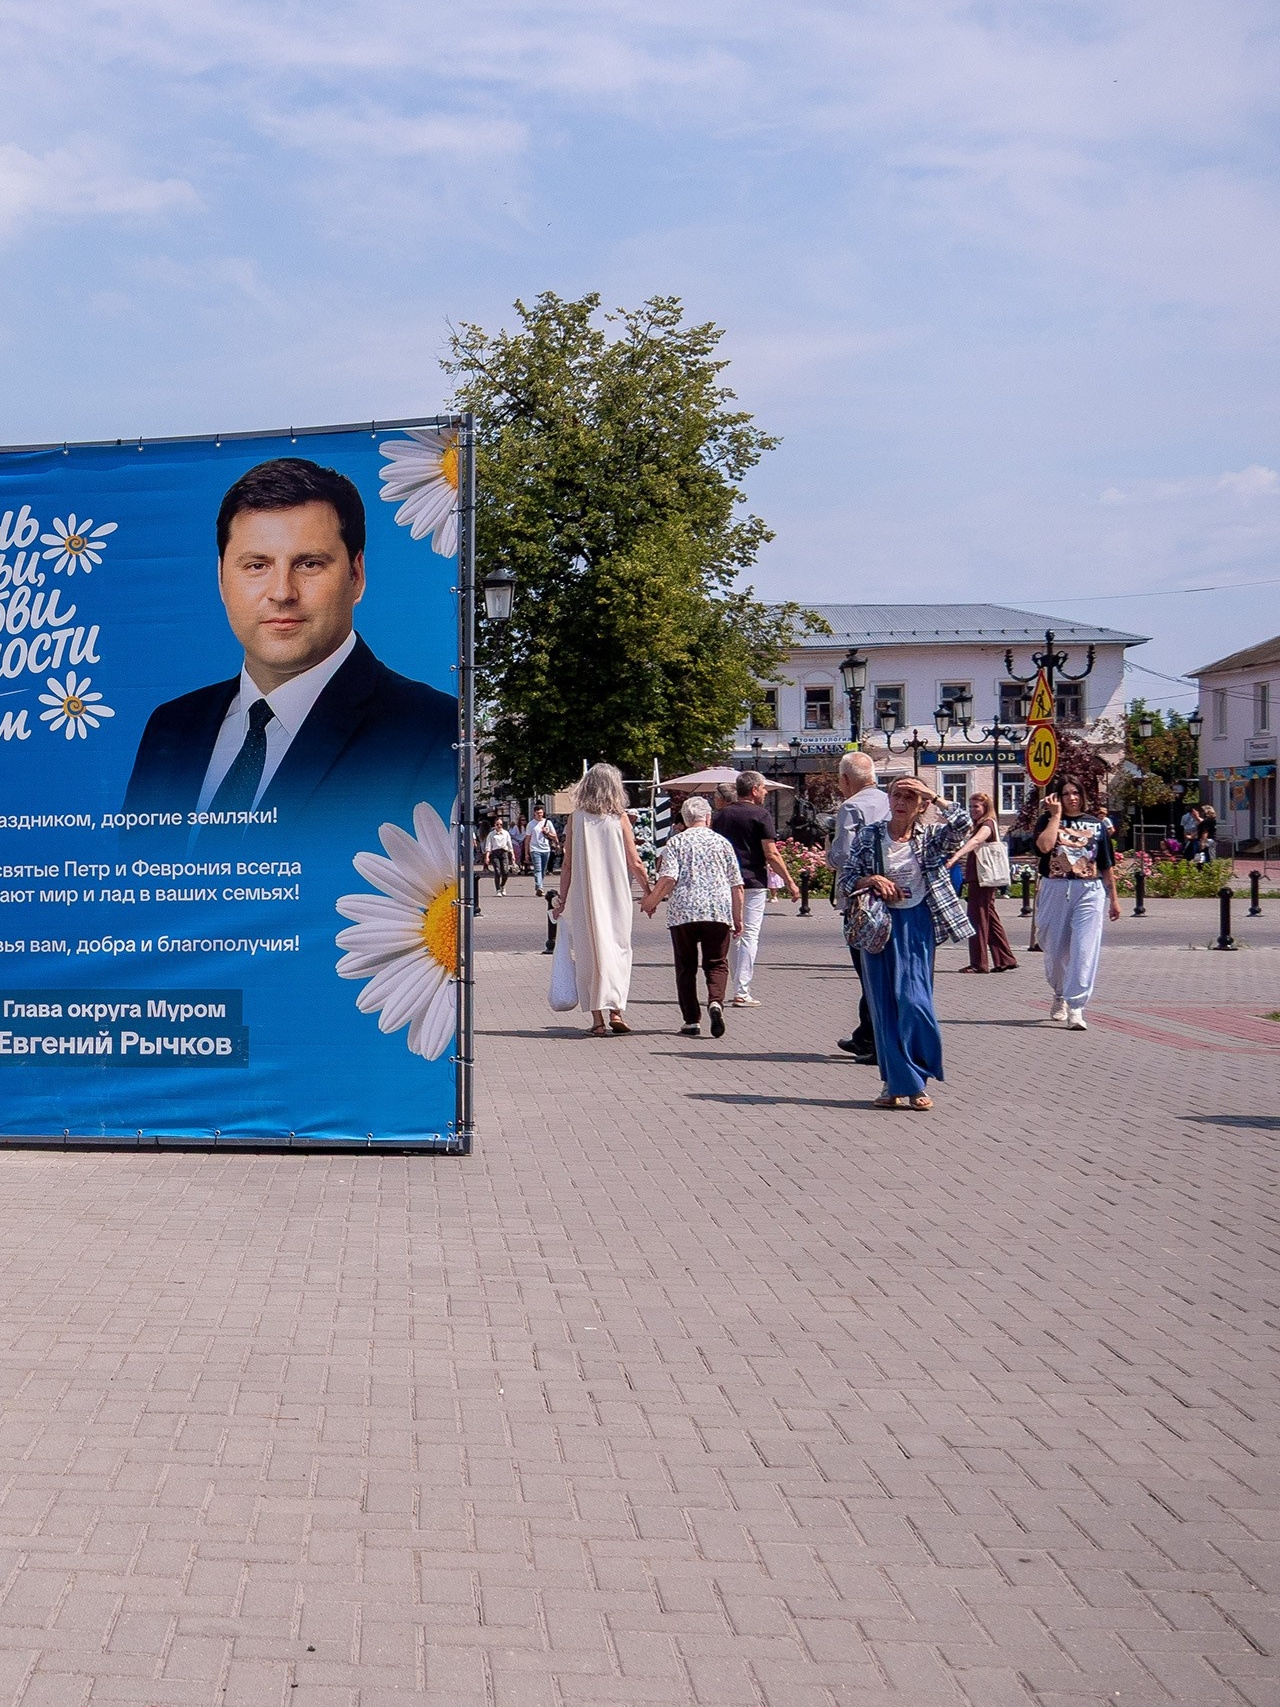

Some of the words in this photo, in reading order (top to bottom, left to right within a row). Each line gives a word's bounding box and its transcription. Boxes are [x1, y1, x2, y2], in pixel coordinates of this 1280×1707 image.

[1033, 742, 1052, 767] 40
[100, 811, 183, 830] дорогие
[187, 806, 278, 825] земляки!
[64, 860, 111, 881] Петр
[115, 864, 127, 877] и
[131, 859, 231, 880] Феврония
[236, 861, 302, 877] всегда
[39, 889, 79, 906] мир
[83, 889, 95, 902] и
[99, 889, 136, 904] лад
[139, 889, 151, 902] в
[155, 888, 218, 902] ваших
[222, 883, 300, 901] семьях!
[30, 940, 72, 956] вам,
[76, 935, 136, 957] добра
[141, 939, 153, 952] и
[157, 934, 300, 956] благополучия!
[3, 1000, 63, 1018] Глава
[67, 1003, 142, 1022] округа
[147, 1000, 226, 1023] Муром
[120, 1031, 233, 1056] Рычков
